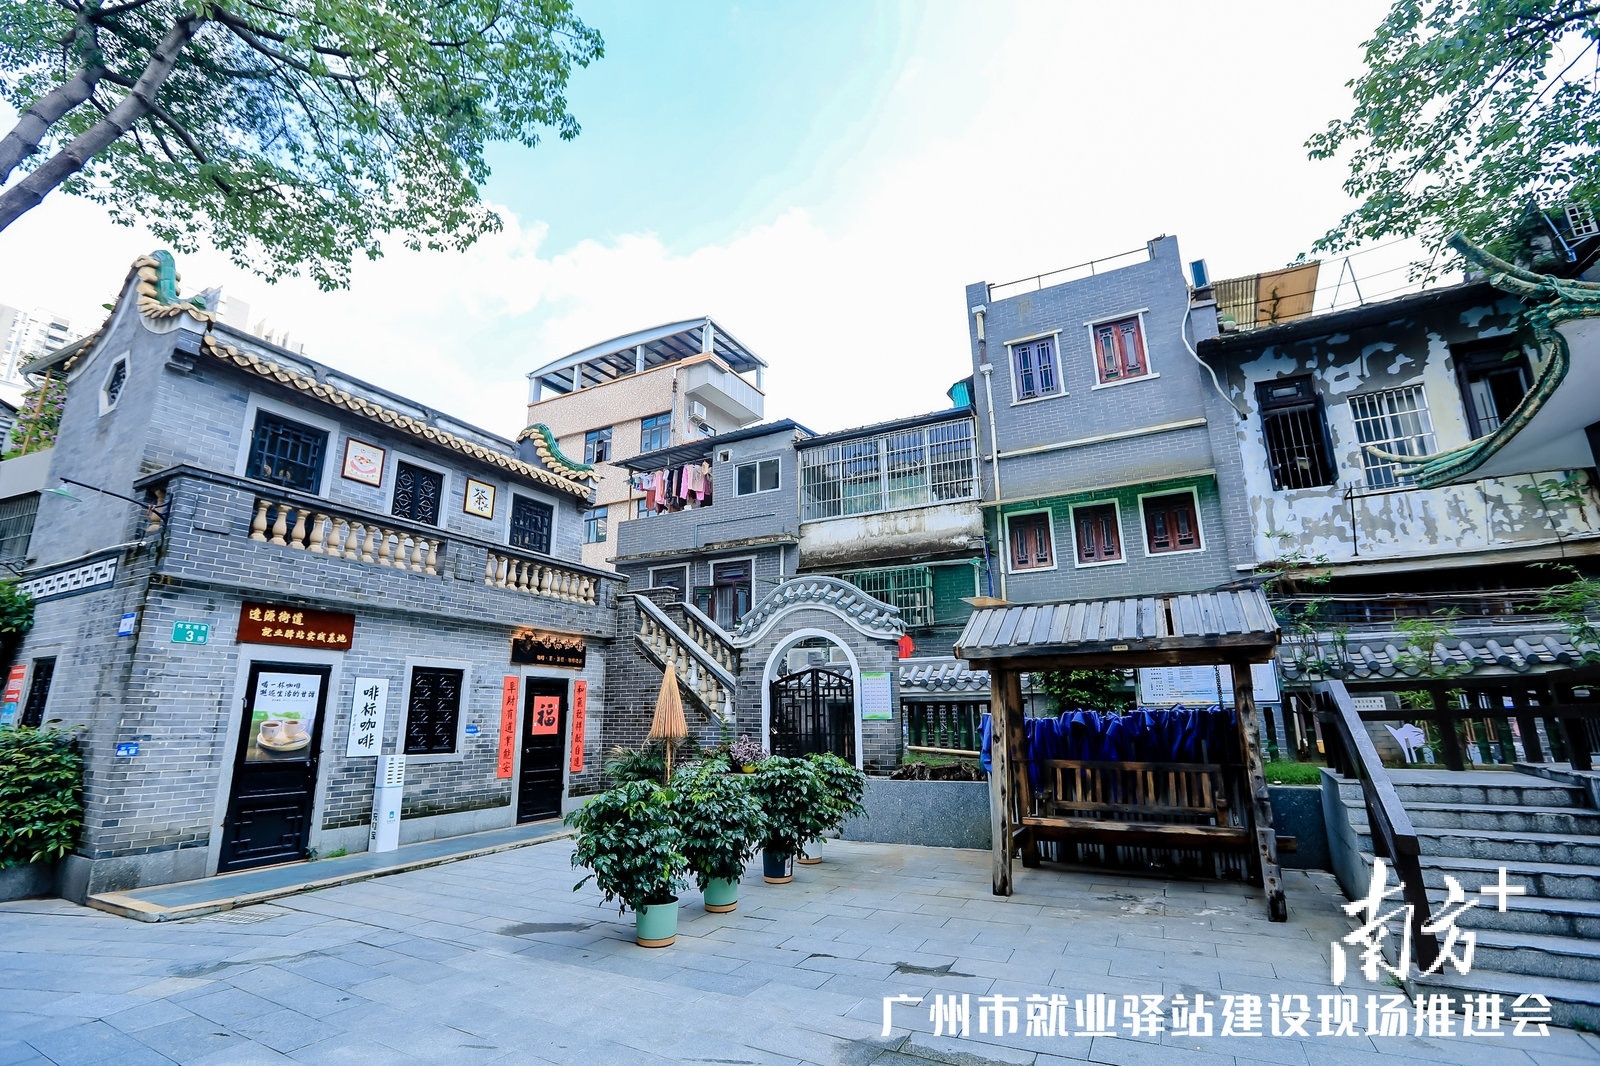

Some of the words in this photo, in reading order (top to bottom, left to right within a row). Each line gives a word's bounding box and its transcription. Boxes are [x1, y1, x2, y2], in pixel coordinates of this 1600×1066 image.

[249, 607, 304, 626] 逢源街道
[357, 684, 380, 750] 啡标咖啡
[536, 703, 556, 727] 福
